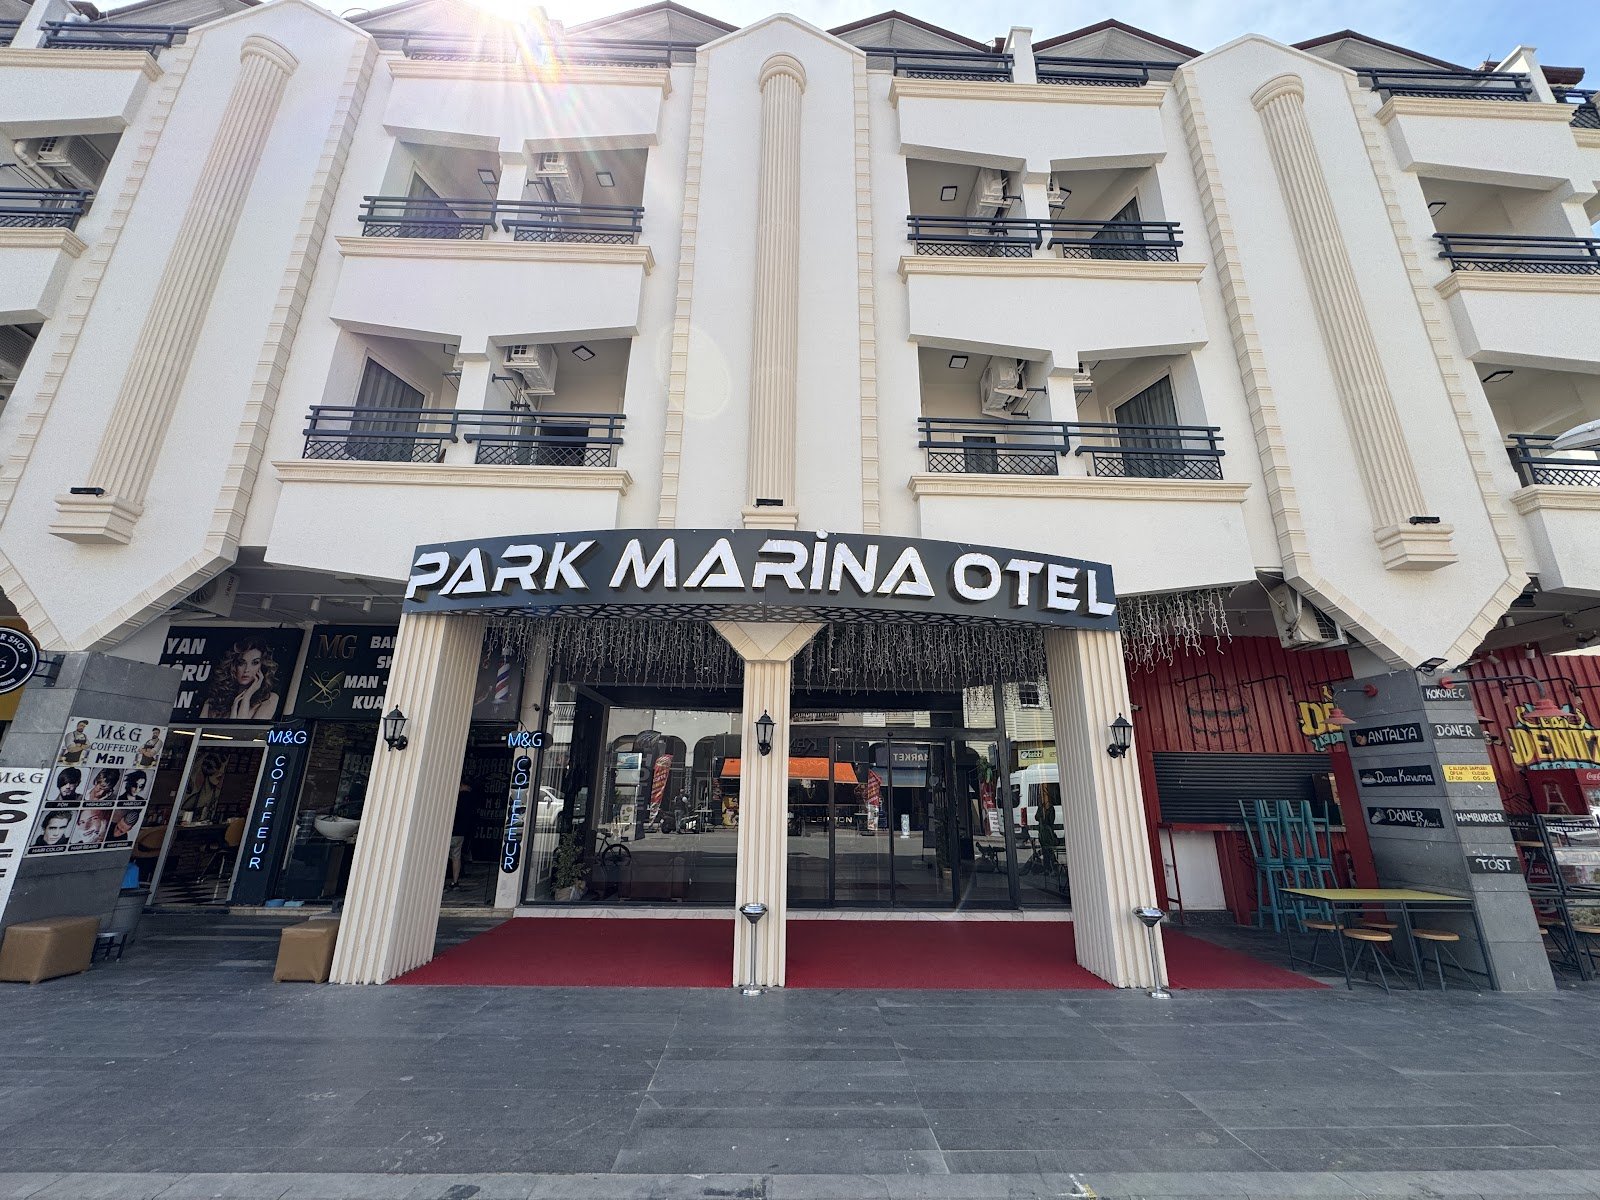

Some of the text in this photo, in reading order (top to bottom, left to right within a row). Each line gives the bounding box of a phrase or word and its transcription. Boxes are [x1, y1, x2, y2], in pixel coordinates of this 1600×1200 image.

[404, 540, 597, 600] PARK
[953, 553, 1117, 616] OTEL
[7, 635, 28, 654] SHOP
[166, 637, 206, 655] YAN
[343, 675, 379, 689] MAN
[1425, 687, 1465, 699] KOKOREÇ
[95, 724, 143, 742] M&G
[267, 729, 307, 744] M&G
[1368, 726, 1418, 743] ANTALYA
[1434, 723, 1475, 737] DÖNER
[507, 731, 542, 748] M&G
[90, 741, 138, 753] COIFFEUR
[95, 752, 125, 765] Man
[1375, 770, 1398, 783] Dana
[503, 757, 529, 870] COIFFEUR
[1386, 808, 1424, 823] DÖNER
[1455, 812, 1504, 823] HAMBURGER
[45, 845, 65, 853] COLOR
[1475, 858, 1511, 871] TOST
